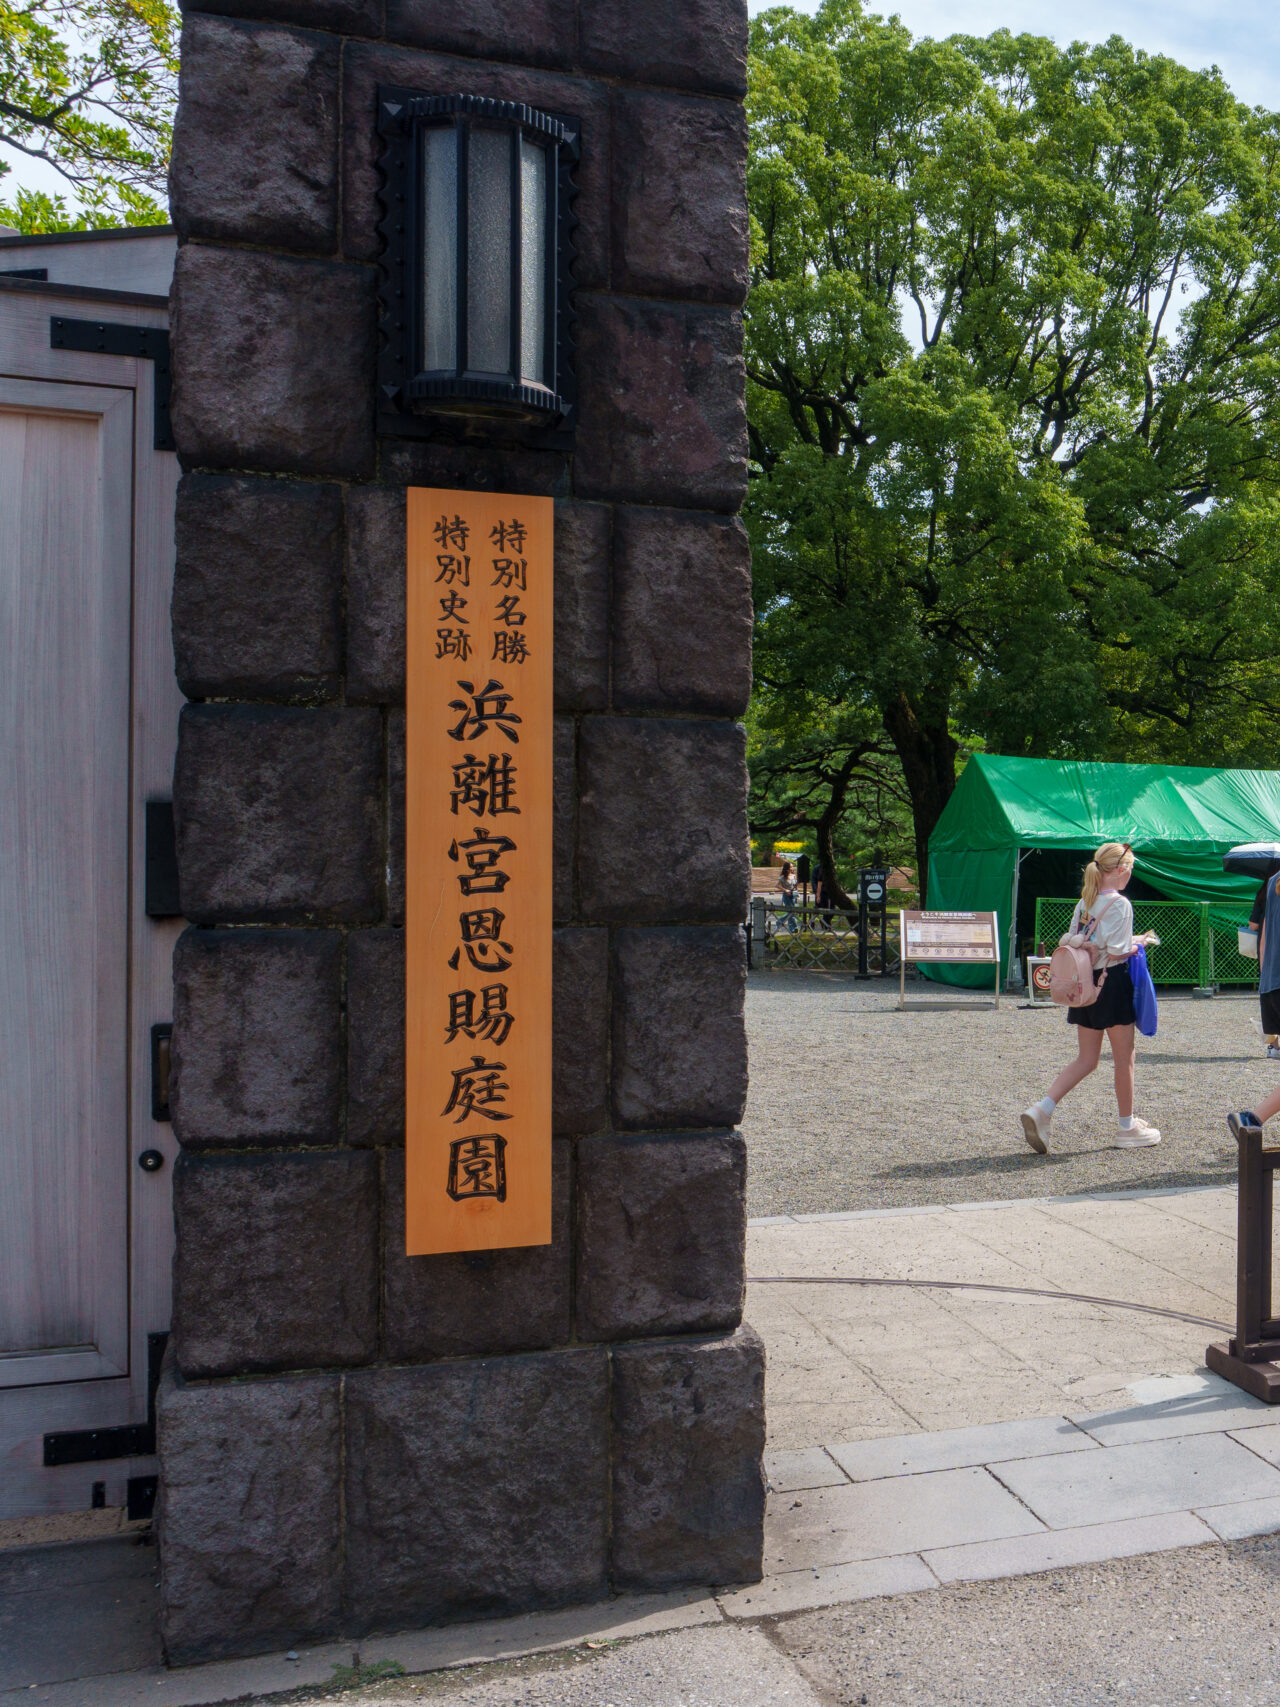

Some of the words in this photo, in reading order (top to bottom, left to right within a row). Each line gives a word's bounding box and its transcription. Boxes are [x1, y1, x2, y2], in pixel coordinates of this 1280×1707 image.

[432, 514, 473, 662] 特別史跡
[488, 518, 531, 664] 特別名勝
[440, 679, 522, 1203] 浜離宮恩賜庭園
